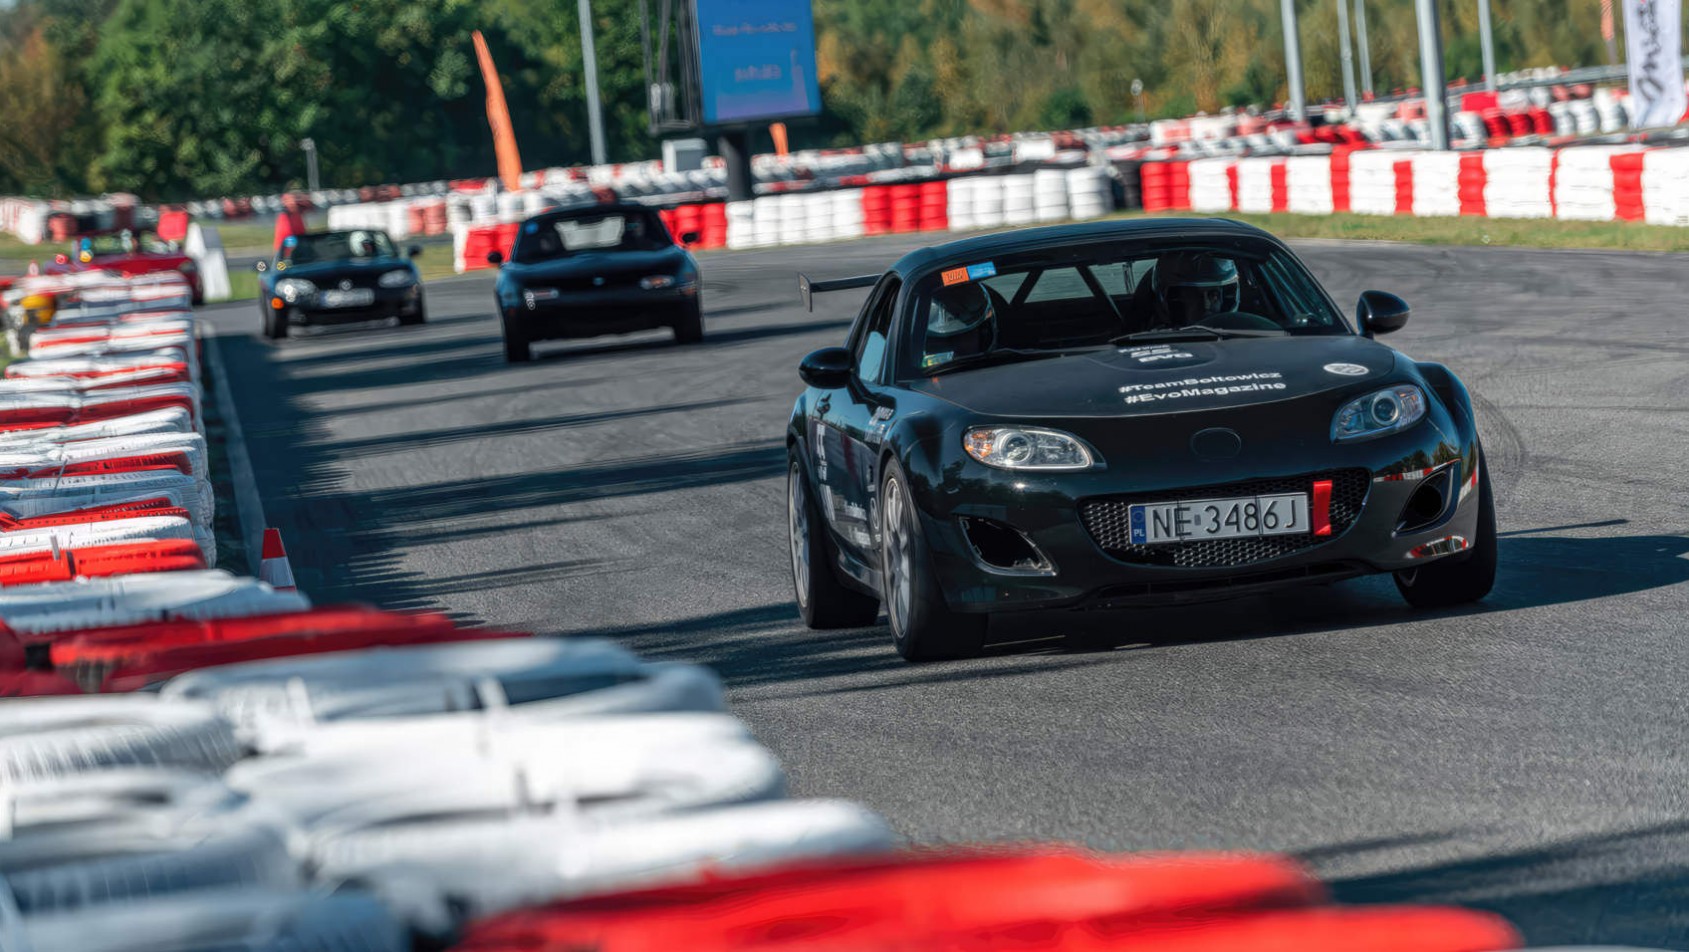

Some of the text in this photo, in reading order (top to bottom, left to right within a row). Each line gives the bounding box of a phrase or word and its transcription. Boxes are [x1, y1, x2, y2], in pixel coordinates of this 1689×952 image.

[1124, 382, 1287, 405] #EvoMagazine
[1133, 499, 1296, 538] PL NE 3486J
